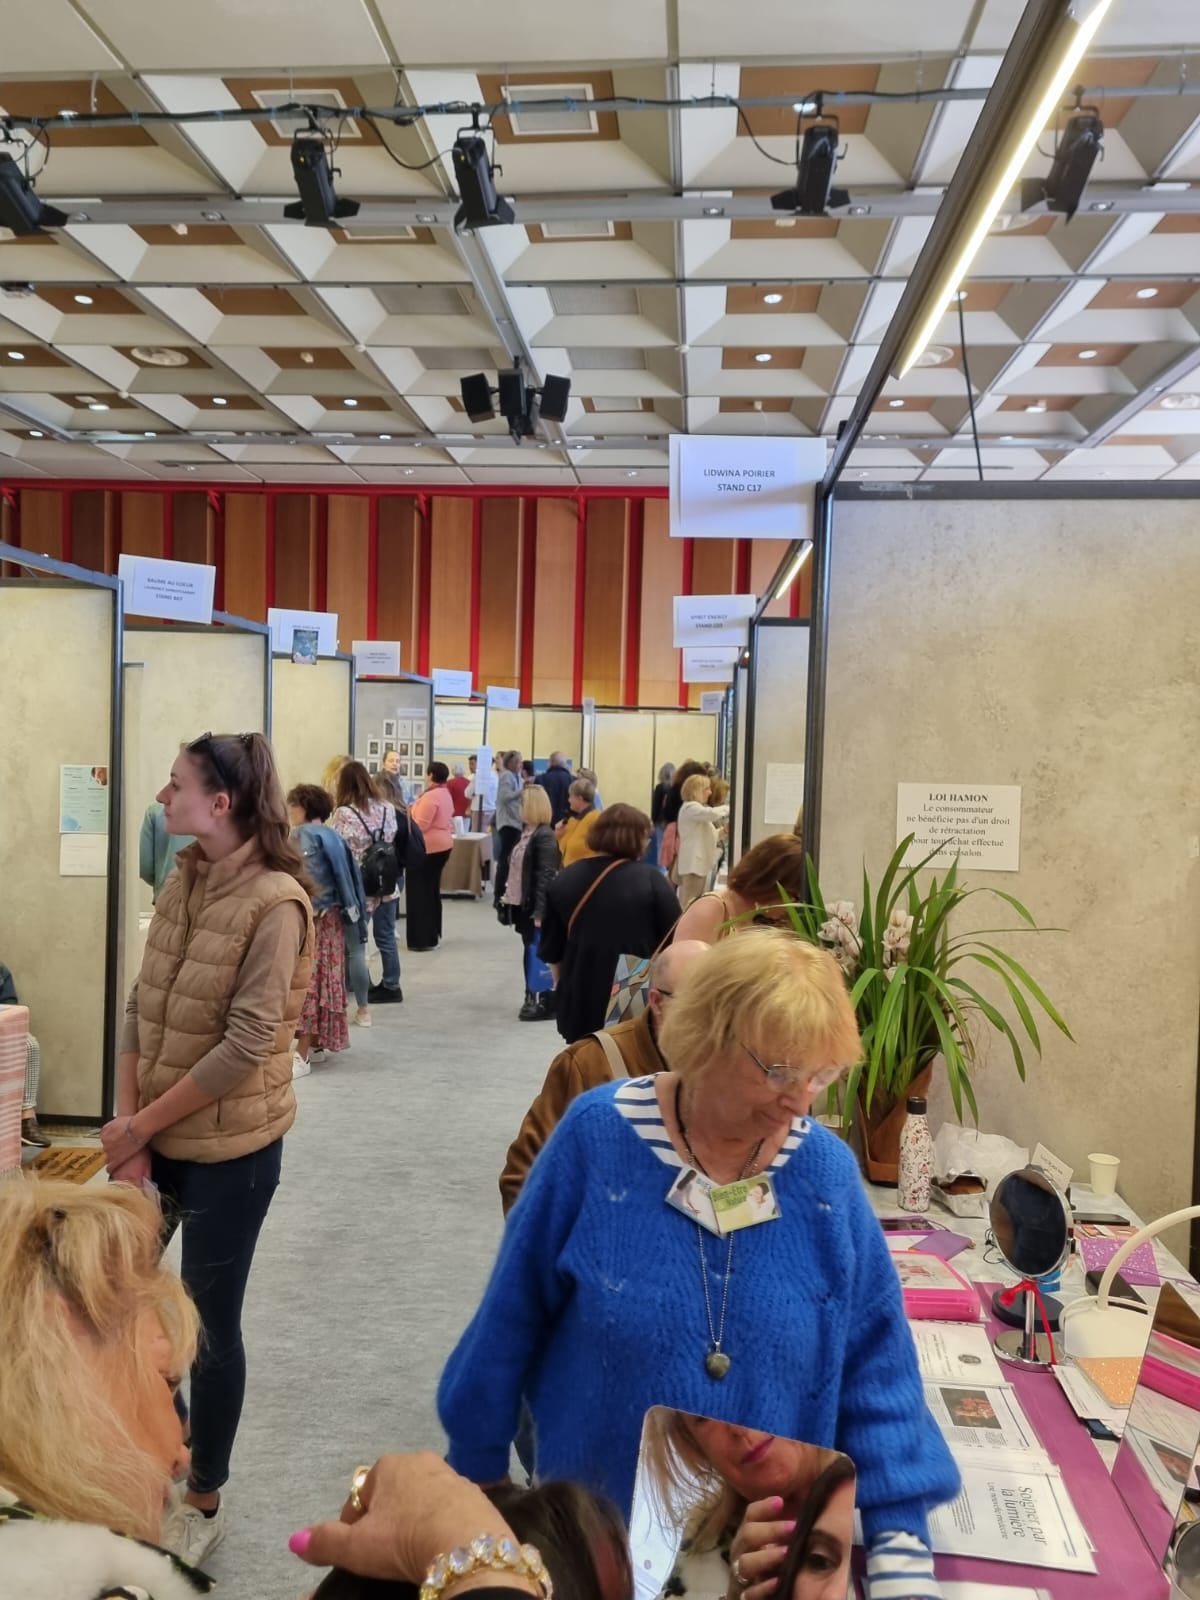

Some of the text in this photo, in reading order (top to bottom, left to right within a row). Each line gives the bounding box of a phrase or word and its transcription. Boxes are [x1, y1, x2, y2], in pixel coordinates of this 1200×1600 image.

[703, 469, 776, 478] LIDWINA POIRIER
[718, 484, 762, 492] STAND C17
[929, 792, 989, 802] LOI HAMON
[923, 803, 994, 814] Le consommateur
[906, 813, 1011, 825] ne bénéficie pas d'un droit
[928, 826, 986, 836] de rétractation
[971, 837, 1005, 847] effectué
[1001, 1488, 1026, 1538] la lumière
[1018, 1486, 1049, 1546] Soigner par
